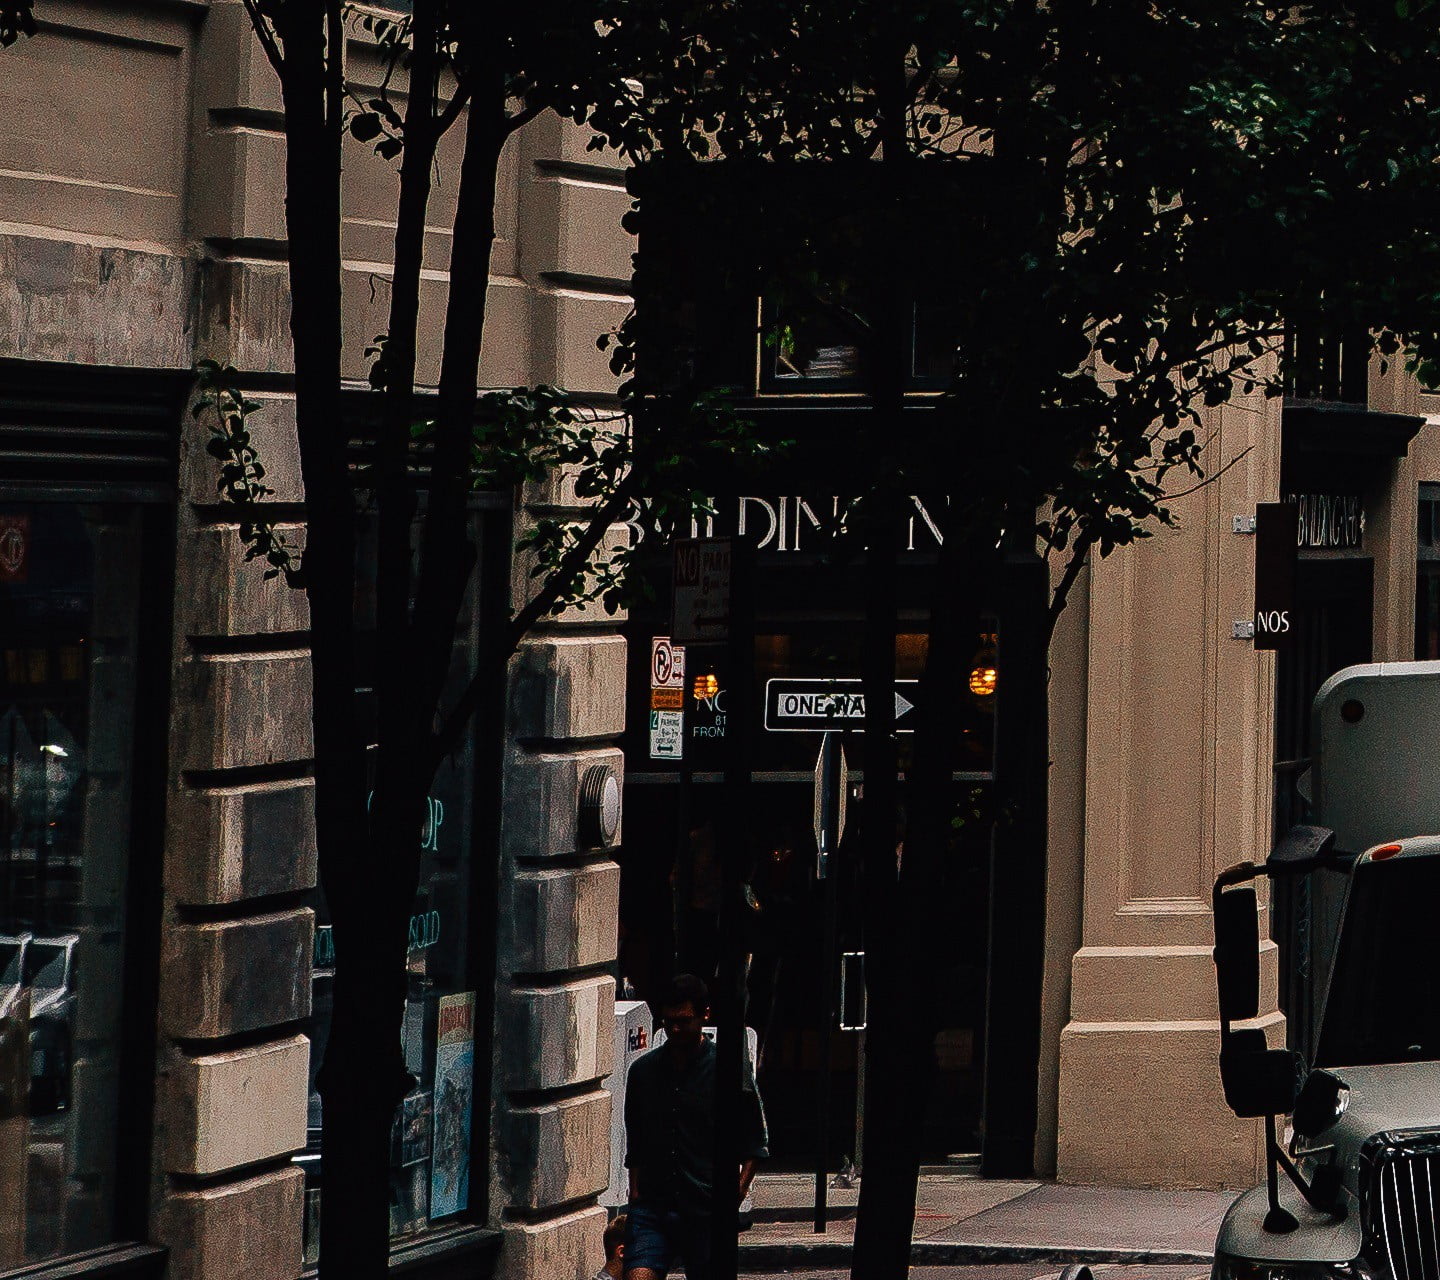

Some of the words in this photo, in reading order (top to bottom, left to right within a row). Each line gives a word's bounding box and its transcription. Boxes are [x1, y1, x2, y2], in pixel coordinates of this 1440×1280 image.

[1257, 610, 1290, 633] NOS
[784, 695, 822, 716] ONE
[693, 727, 725, 737] FRON
[628, 1026, 648, 1052] FedEx
